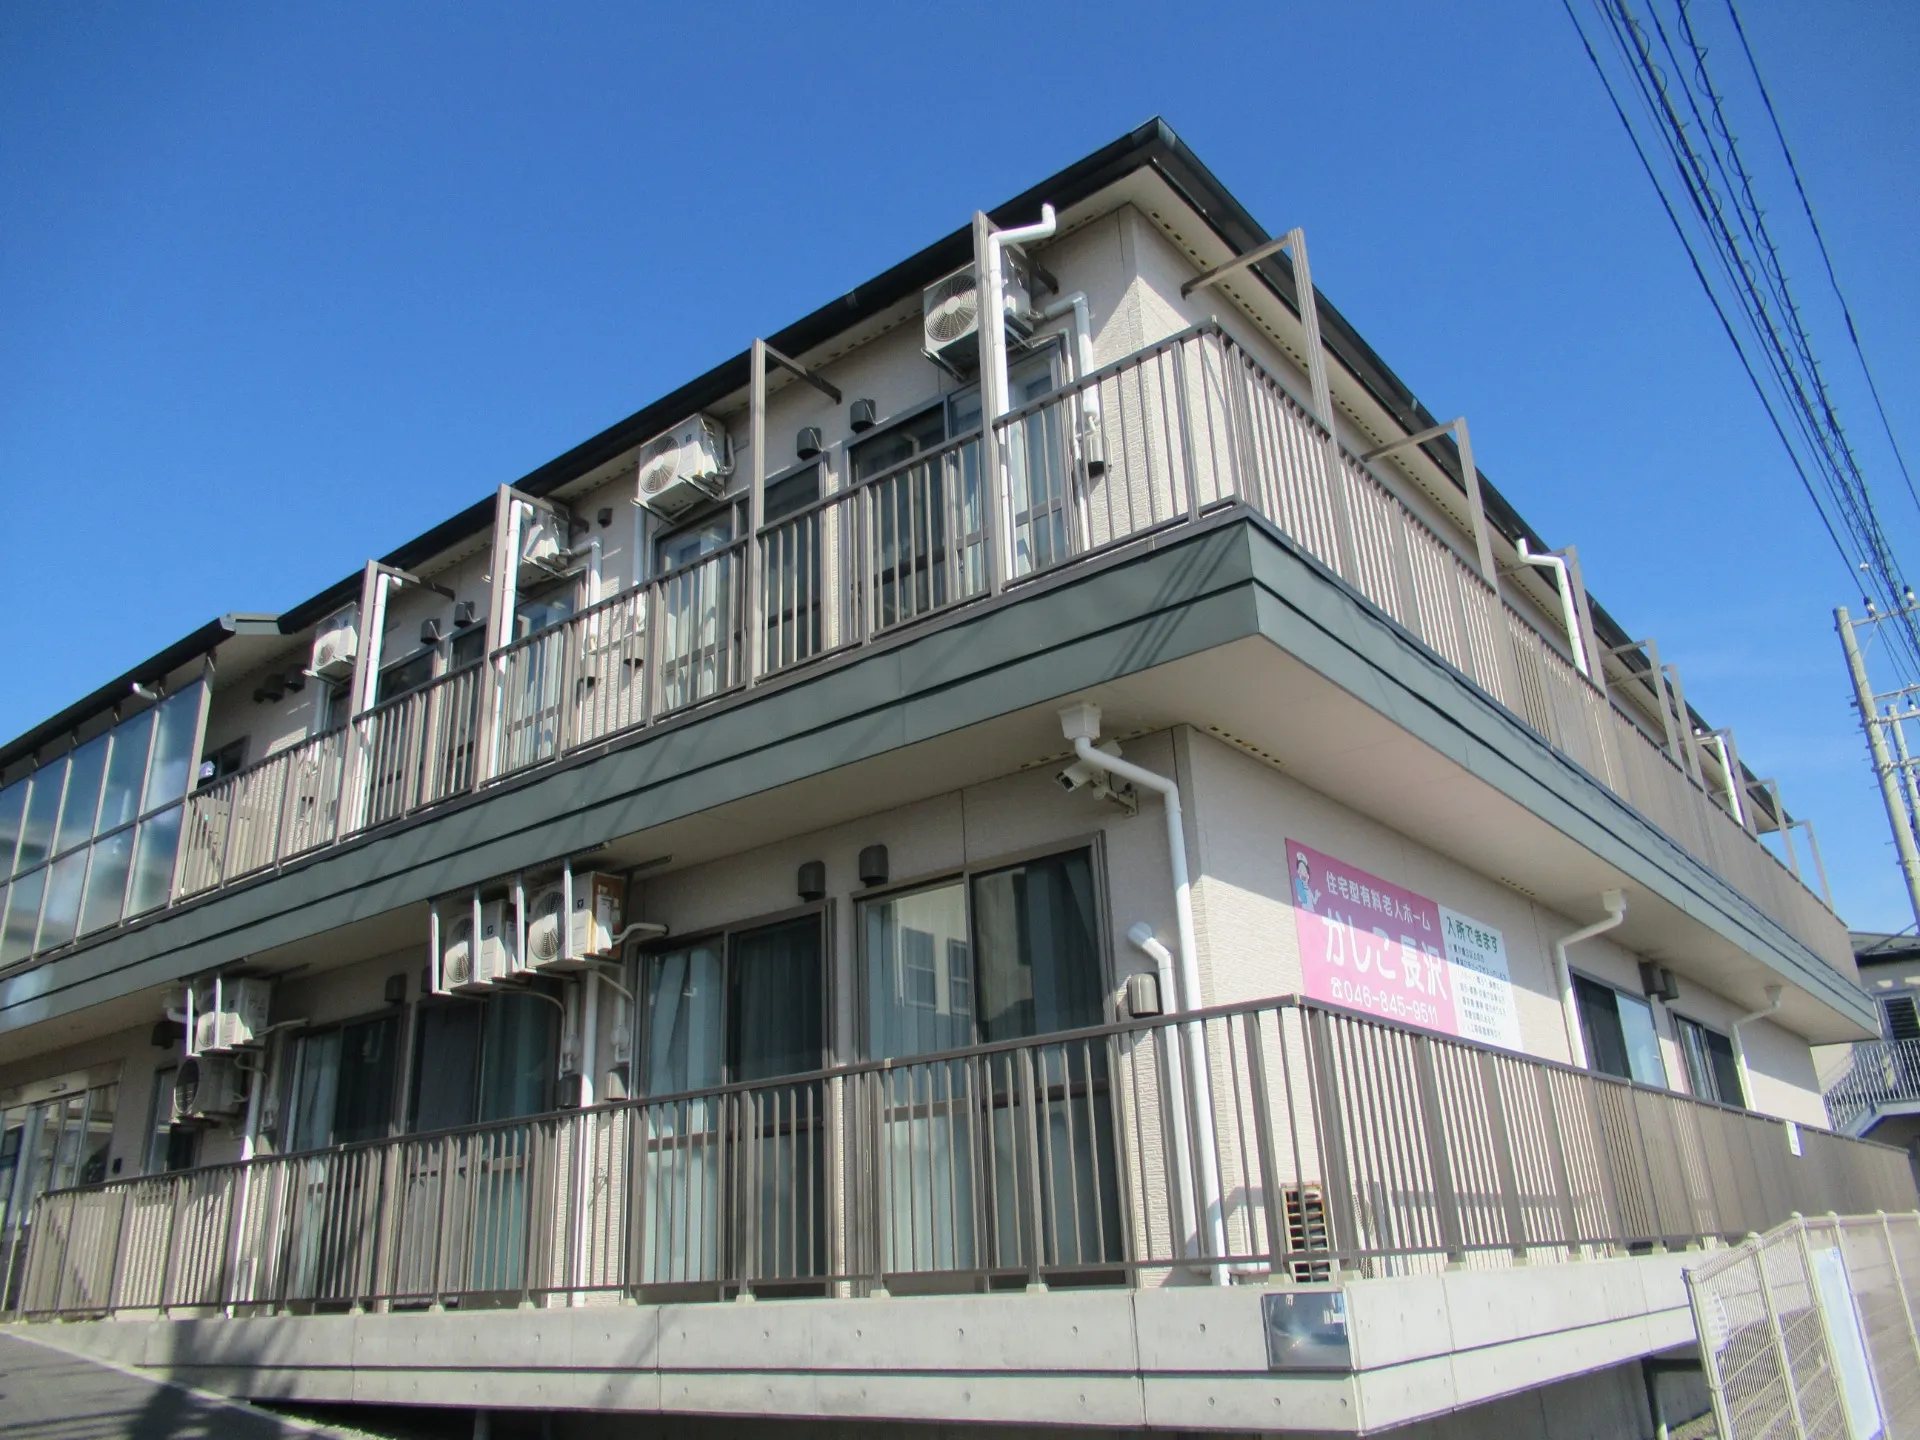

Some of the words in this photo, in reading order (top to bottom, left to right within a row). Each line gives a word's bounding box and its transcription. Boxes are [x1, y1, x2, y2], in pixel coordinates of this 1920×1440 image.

[1326, 870, 1431, 931] 住宅型有料老人ホーム
[1446, 916, 1497, 953] 入所できます
[1344, 981, 1439, 1025] 046-845-9511
